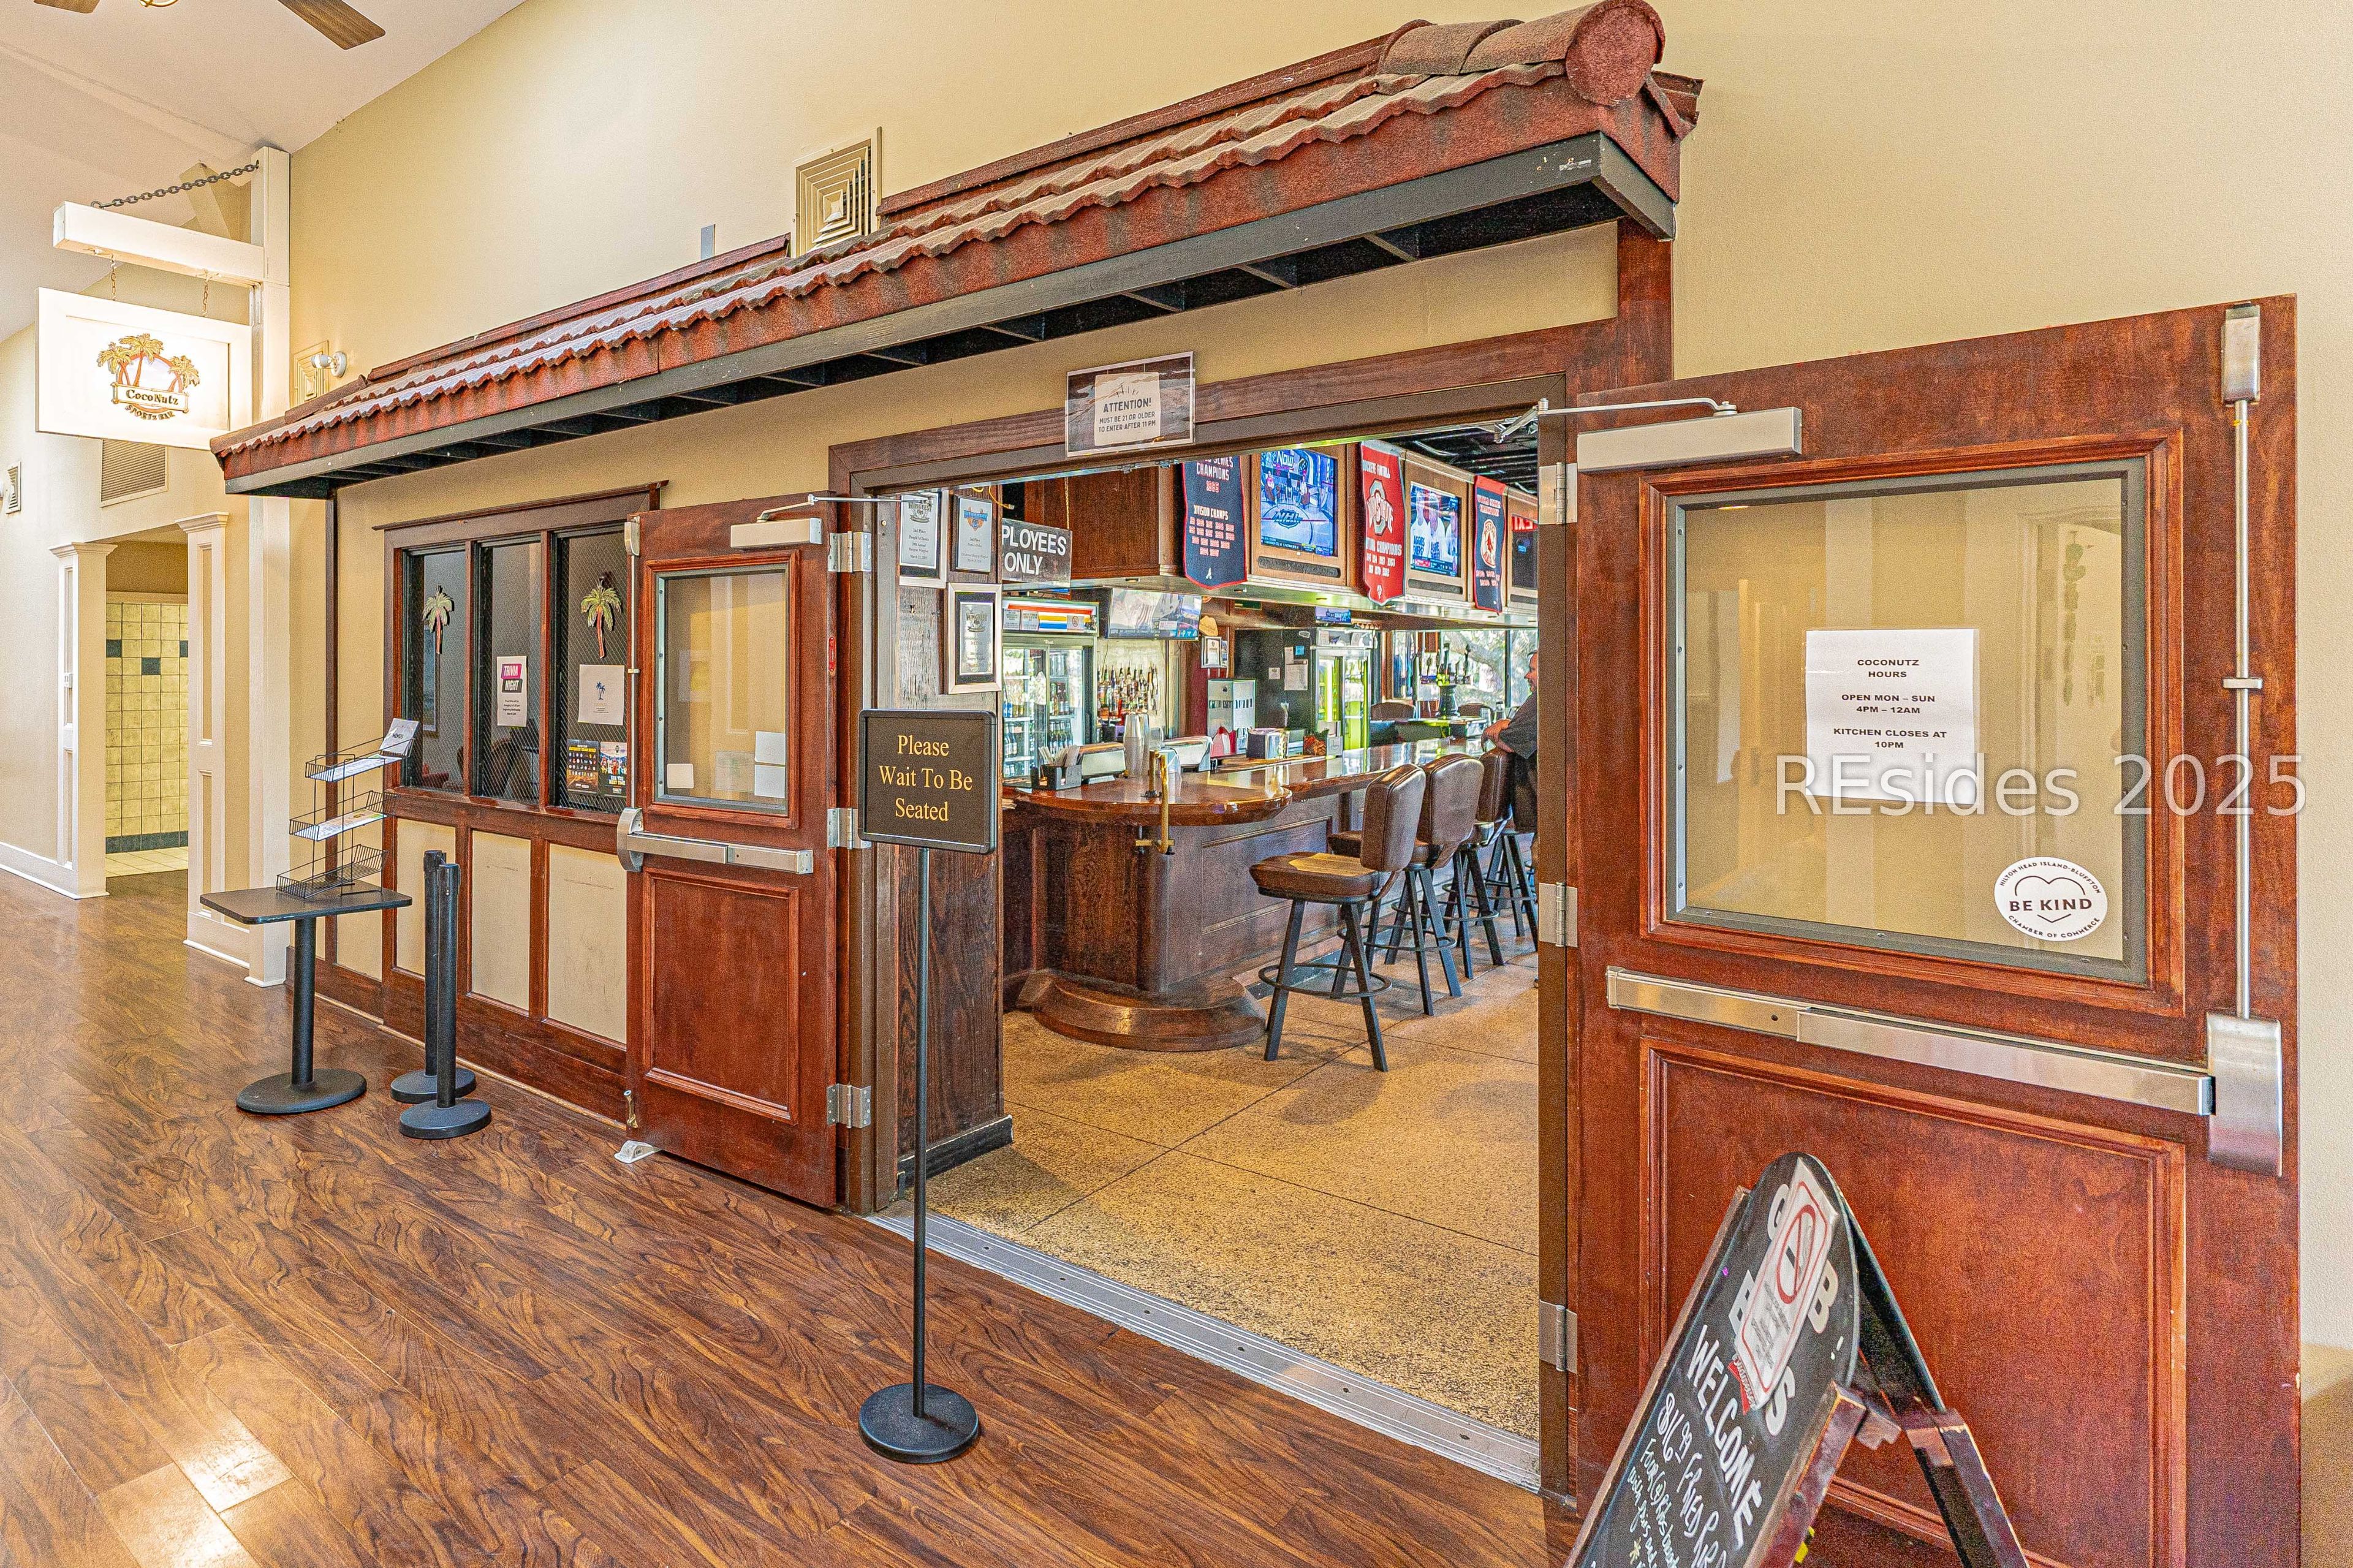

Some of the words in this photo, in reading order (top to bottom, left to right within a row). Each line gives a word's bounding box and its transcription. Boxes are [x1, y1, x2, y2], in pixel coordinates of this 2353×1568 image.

[126, 389, 179, 405] CocoNutz
[125, 404, 157, 420] SPORTZ
[158, 411, 175, 420] BAR
[1103, 398, 1151, 413] ATTENTION!
[1138, 411, 1155, 420] OLDER
[1124, 422, 1140, 430] AFTER
[1196, 462, 1229, 481] CHAMPIONS
[1210, 508, 1229, 520] CHAMPS
[1273, 511, 1303, 521] NHL
[1004, 552, 1043, 575] ONLY
[504, 665, 518, 676] TRIVIA
[505, 680, 519, 691] NIGHT
[897, 735, 949, 756] Please
[879, 765, 917, 787] Wait
[921, 768, 944, 789] To
[949, 770, 972, 790] Be
[895, 798, 949, 822] Seated
[2000, 868, 2018, 886] HILTON
[2018, 862, 2037, 871] HEAD
[2040, 862, 2102, 894] ISLAND-BLUFFTON
[2009, 901, 2033, 912] BE
[2040, 898, 2092, 911] KIND
[2009, 915, 2043, 936] CHAMBER
[2061, 917, 2100, 938] COMMERCE
[1687, 1324, 1762, 1551] WELCOME
[1677, 1452, 1704, 1538] FRIED
